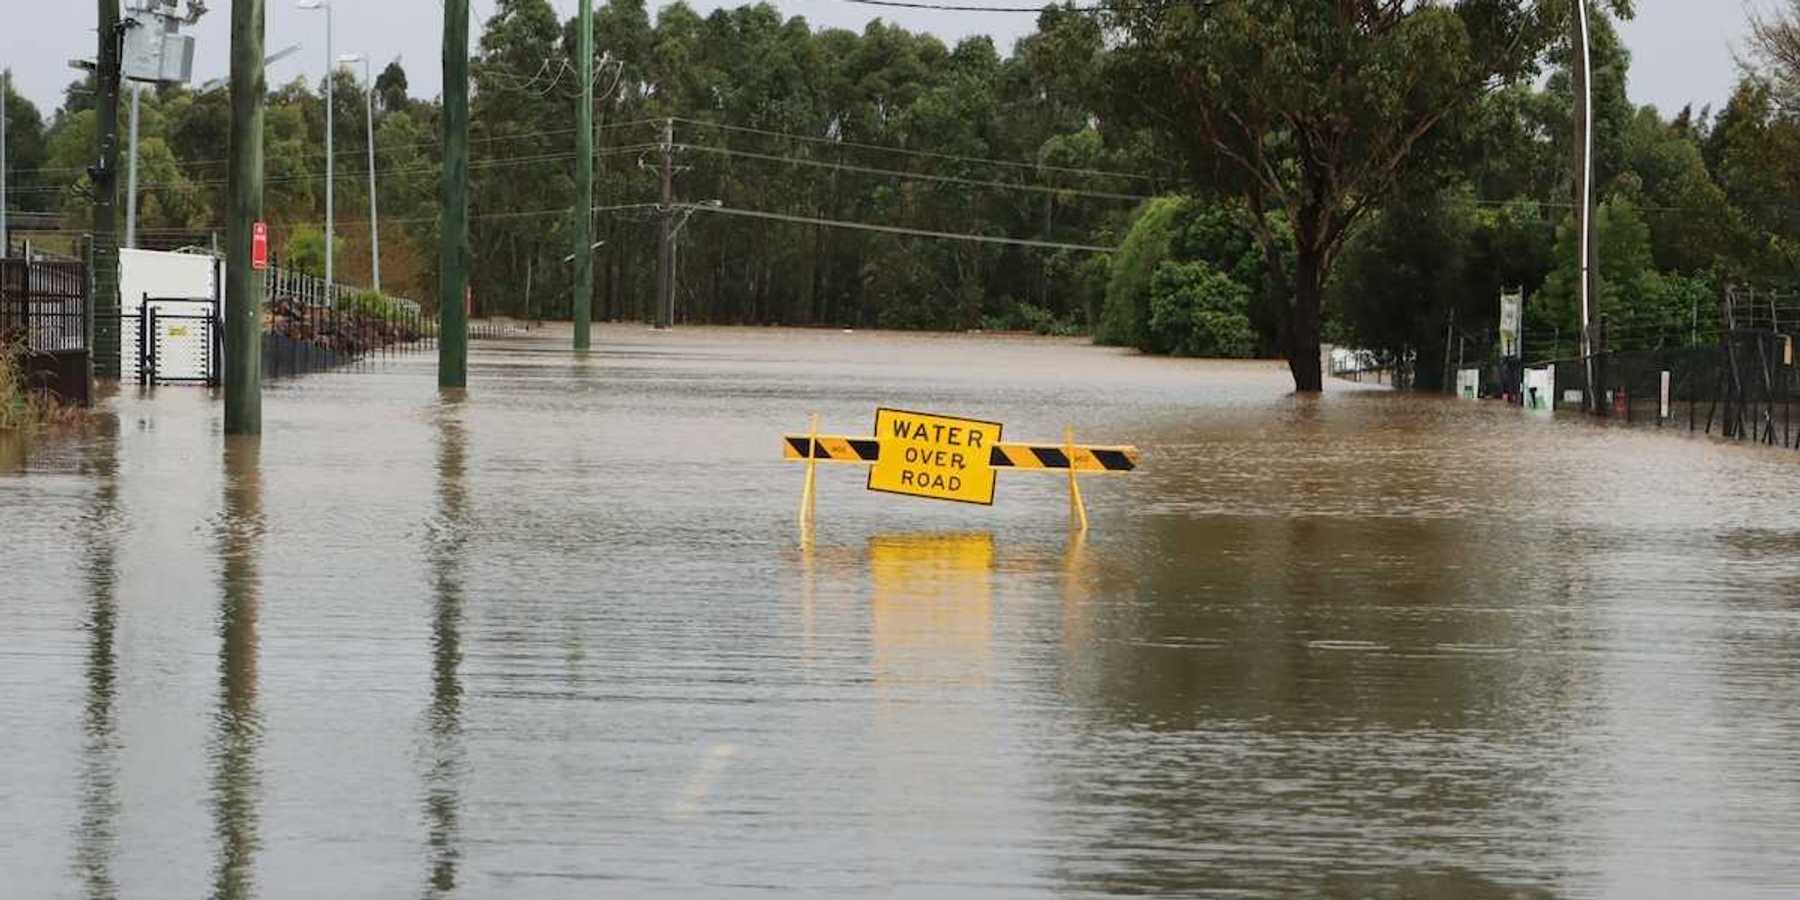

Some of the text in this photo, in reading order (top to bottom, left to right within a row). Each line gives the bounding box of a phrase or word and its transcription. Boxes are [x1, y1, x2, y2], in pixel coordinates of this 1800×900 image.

[893, 419, 983, 448] WATER
[905, 447, 965, 470] OVER
[901, 469, 961, 491] ROAD
